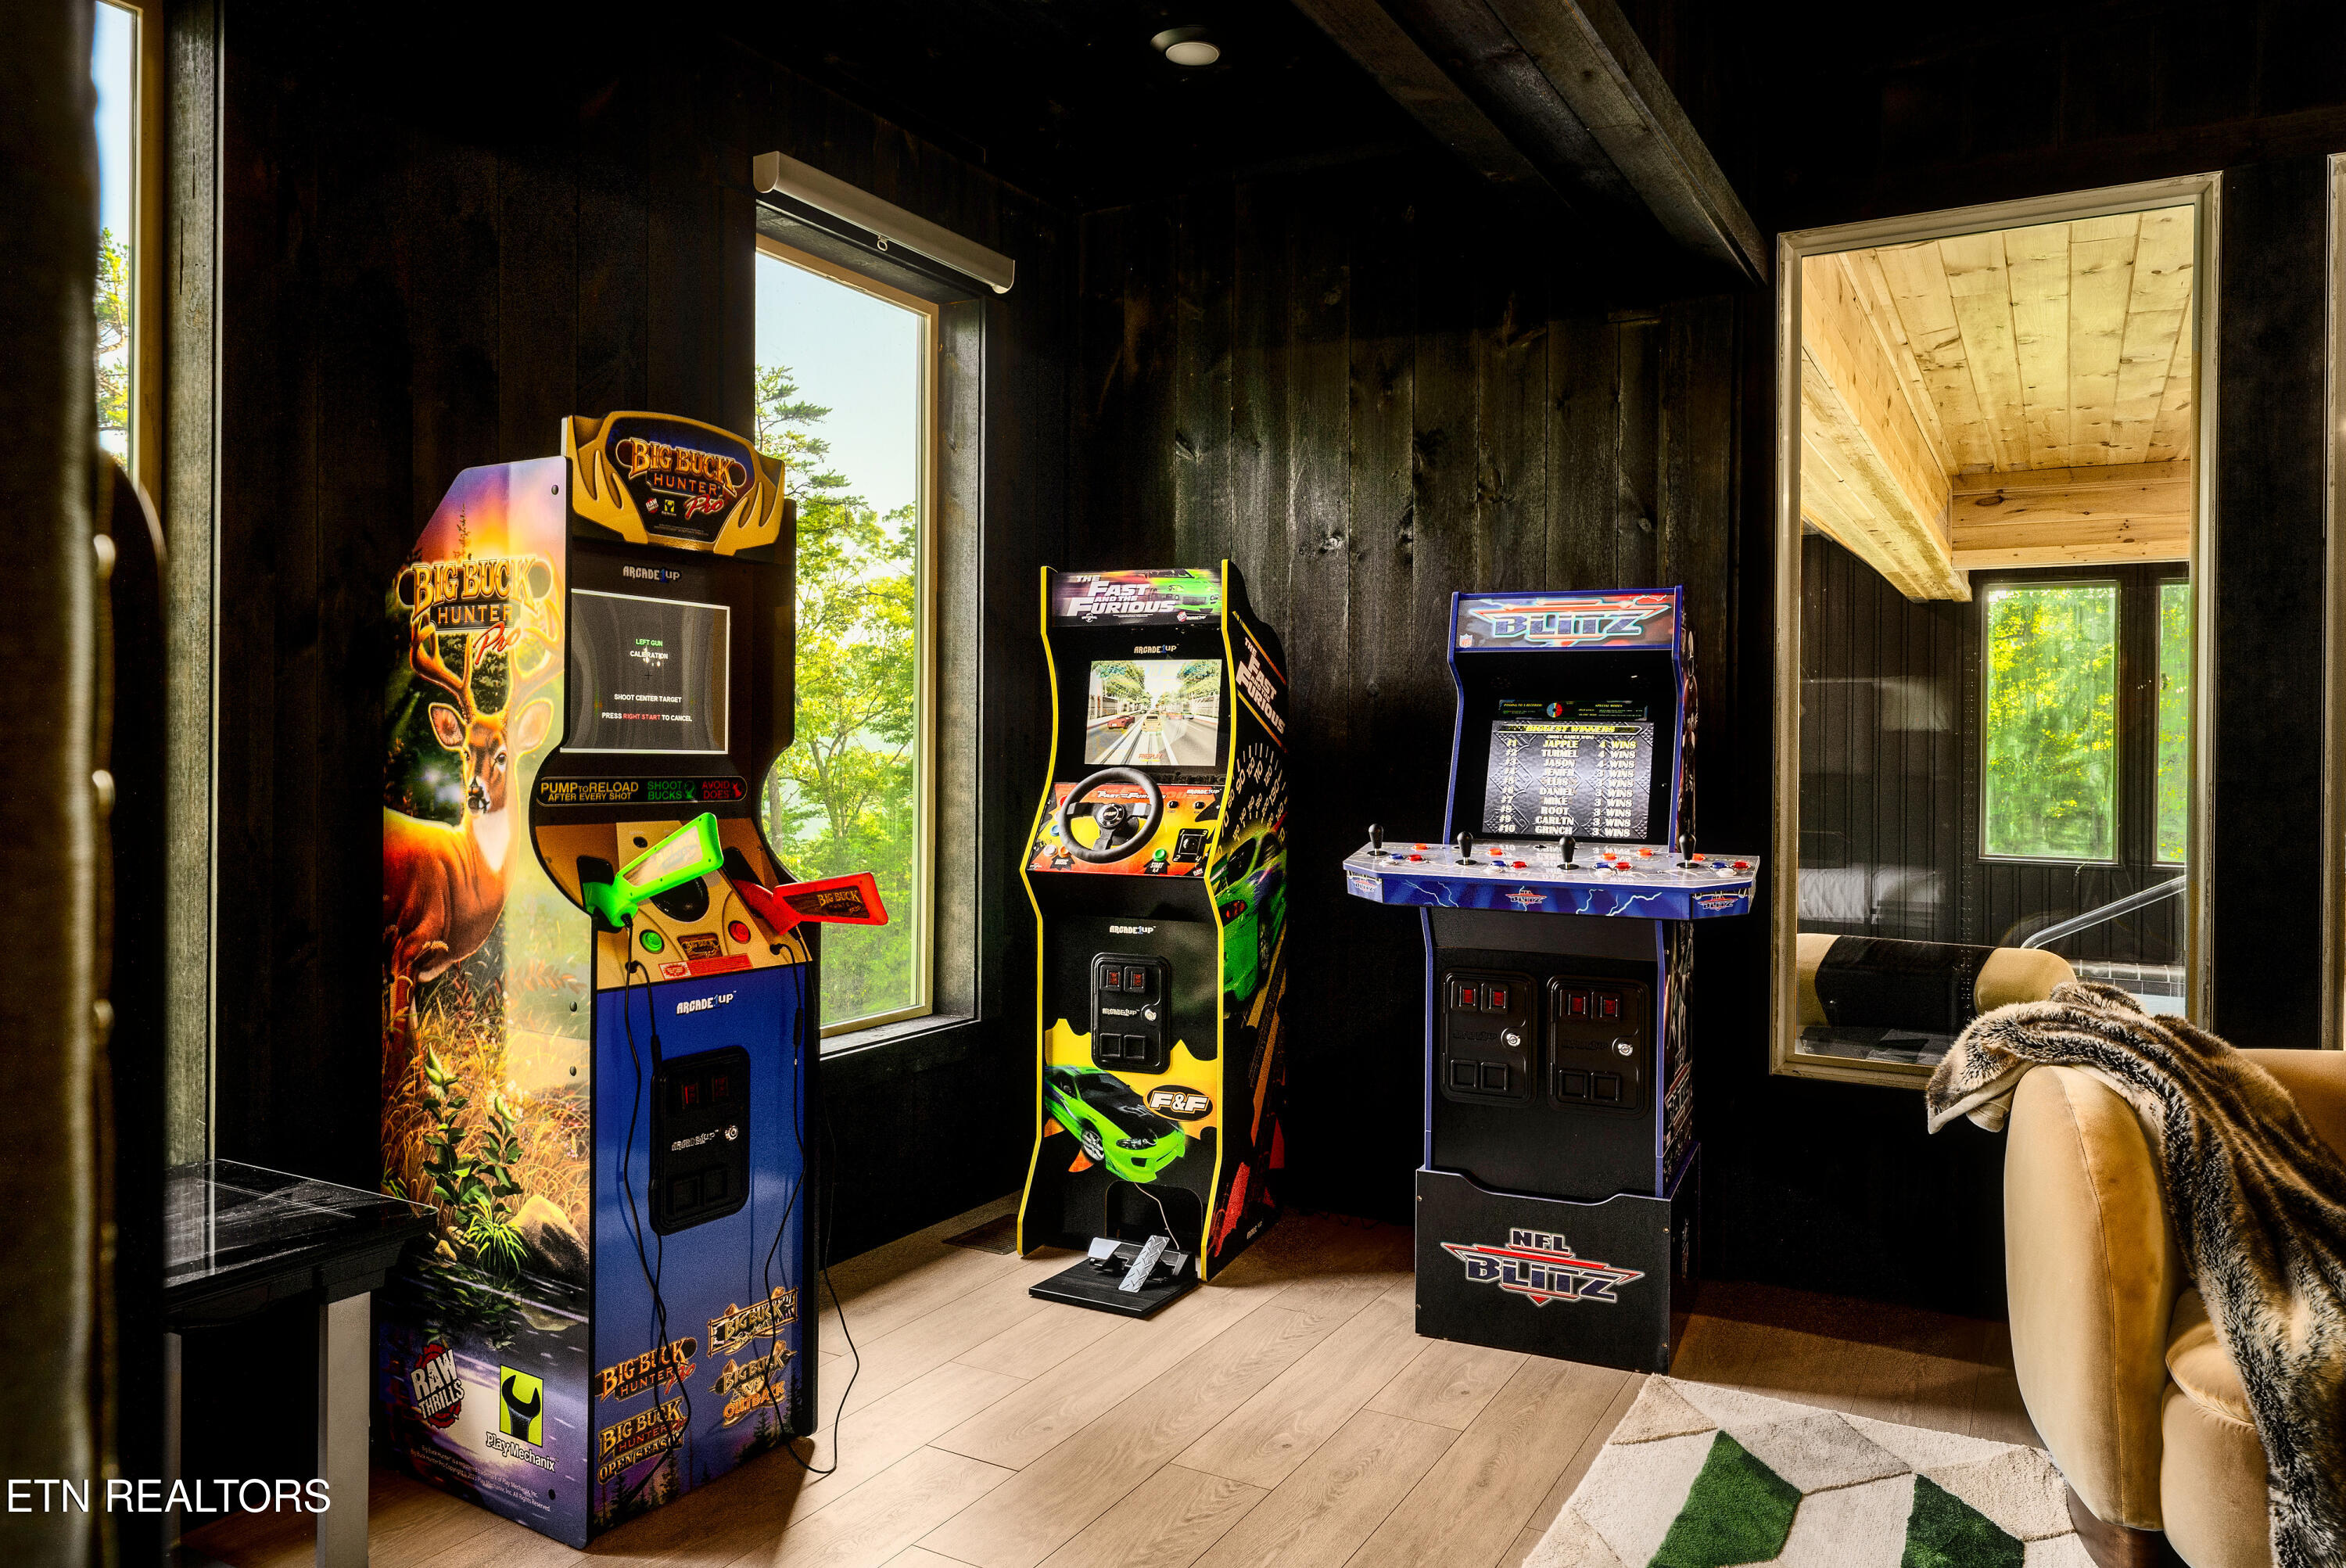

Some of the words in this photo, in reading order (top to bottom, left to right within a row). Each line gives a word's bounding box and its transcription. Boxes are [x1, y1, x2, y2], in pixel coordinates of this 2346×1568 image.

[630, 437, 673, 479] BIG
[675, 447, 737, 497] BUCK
[654, 473, 718, 495] HUNTER
[684, 493, 725, 519] Pro
[412, 563, 459, 623] BIG
[461, 556, 539, 616] BUCK
[1088, 581, 1150, 597] FAST
[438, 604, 514, 624] HUNTER
[1067, 597, 1176, 616] FURIOUS
[1490, 612, 1644, 637] BLITZ
[472, 621, 522, 666] Pro
[1245, 637, 1257, 658] THE
[1248, 655, 1277, 700] FAST
[1250, 676, 1261, 691] AND
[1261, 689, 1271, 702] THE
[1236, 661, 1286, 734] FURIOUS
[1542, 740, 1579, 748] JAPPLE
[1544, 759, 1576, 768] JASON
[1609, 760, 1635, 769] WINS
[540, 782, 578, 795] PUMP
[589, 781, 639, 793] RELOAD
[647, 780, 683, 791] SHOOT
[701, 780, 730, 791] AVOID
[703, 790, 730, 799] DOES
[1236, 769, 1246, 795] 90
[1539, 788, 1575, 796] DANIEL
[1607, 789, 1633, 798] WINS
[548, 793, 577, 802] AFTER
[579, 792, 607, 802] EVERY
[609, 791, 632, 800] SHOT
[647, 791, 683, 800] BUCKS
[1543, 797, 1569, 806] MIKE
[1606, 799, 1633, 808] WINS
[1535, 816, 1574, 825] CARLTN
[1605, 819, 1630, 827] WINS
[1541, 806, 1569, 815] ROOT
[1605, 809, 1632, 817] WINS
[1534, 825, 1573, 835] GRINCH
[1604, 828, 1630, 837] WINS
[816, 893, 834, 906] BIG
[1150, 1091, 1209, 1112] F&F
[1511, 1229, 1571, 1254] NFL
[1465, 1253, 1622, 1302] BLITZ
[725, 1315, 747, 1341] BIG
[411, 1349, 458, 1401] RAW
[601, 1359, 634, 1402] BIG
[620, 1368, 673, 1396] HUNTER
[723, 1369, 747, 1394] BIG
[418, 1380, 465, 1419] THRILLS
[601, 1420, 633, 1461] BIG
[619, 1425, 668, 1452] HUNTER
[486, 1432, 510, 1458] Play
[510, 1441, 557, 1473] Mechanix
[599, 1452, 635, 1481] OPEN
